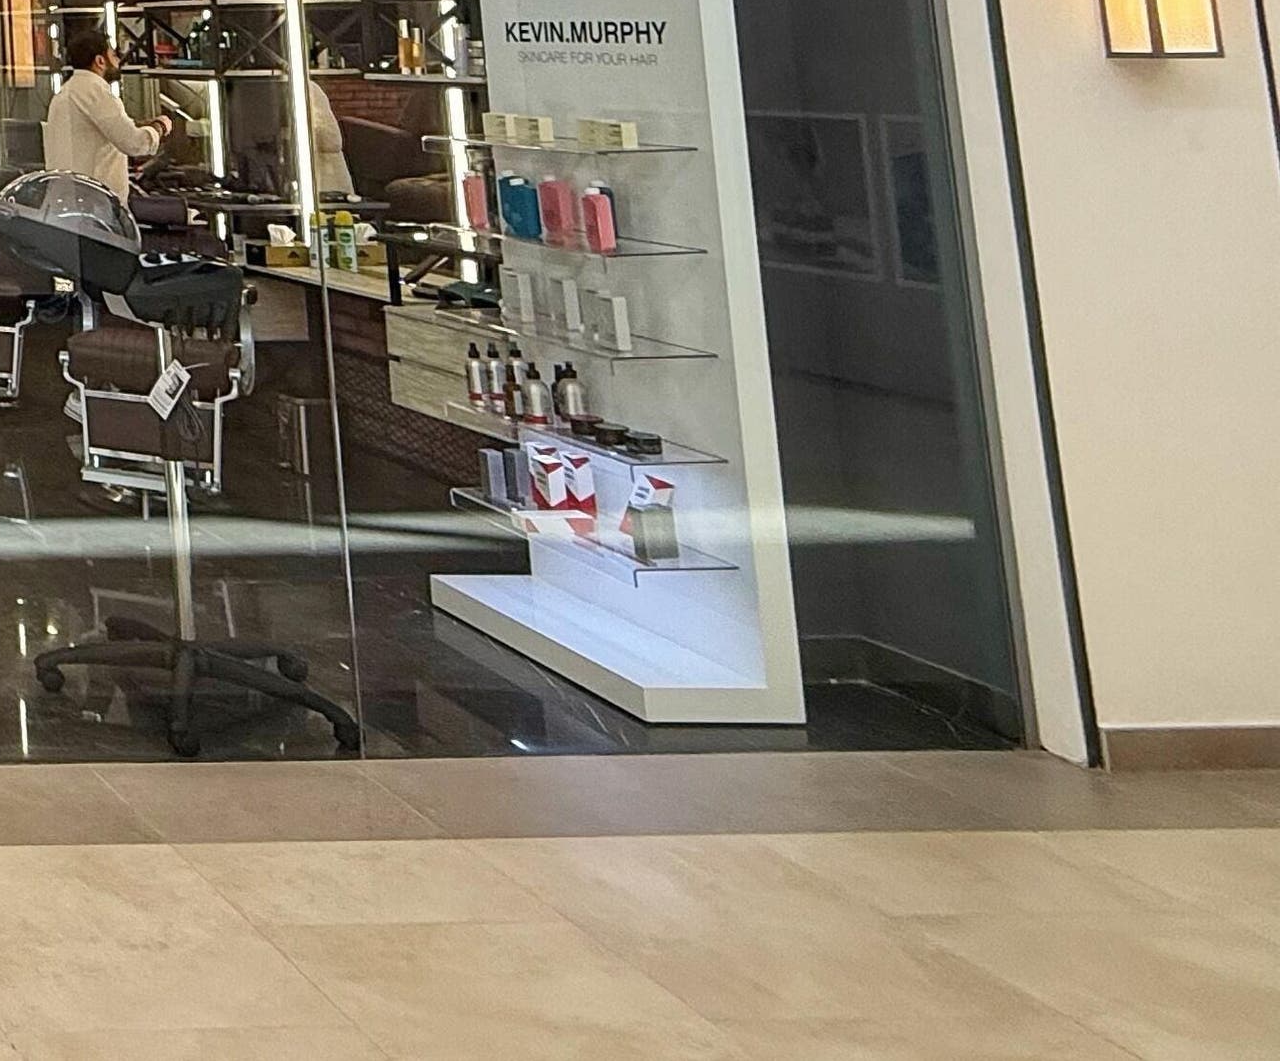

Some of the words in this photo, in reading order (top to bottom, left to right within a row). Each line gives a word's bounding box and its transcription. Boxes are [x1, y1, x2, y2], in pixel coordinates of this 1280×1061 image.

[505, 21, 667, 44] KEVIN.MURPHY
[518, 50, 568, 64] SKINCARE
[571, 51, 593, 65] FOR
[596, 52, 628, 66] YOUR
[630, 54, 659, 66] HAIR
